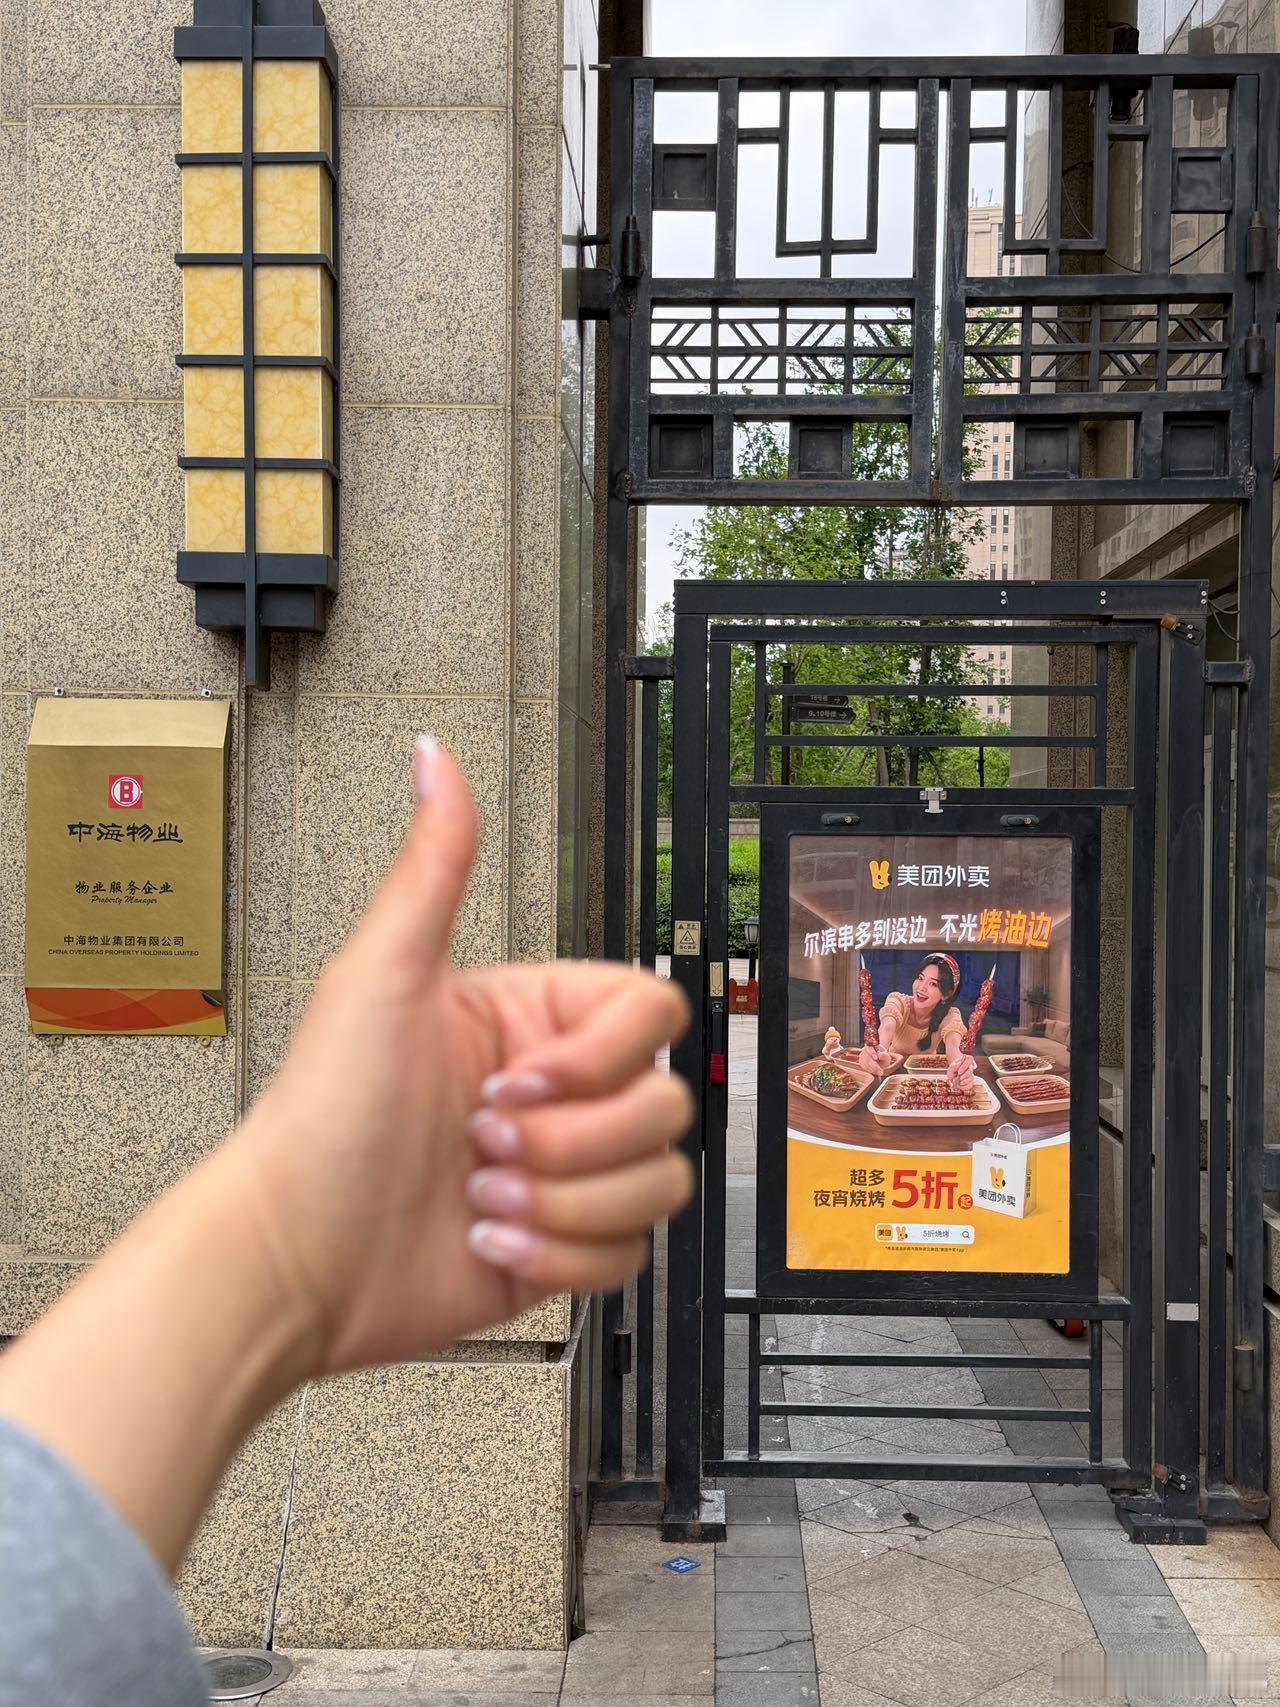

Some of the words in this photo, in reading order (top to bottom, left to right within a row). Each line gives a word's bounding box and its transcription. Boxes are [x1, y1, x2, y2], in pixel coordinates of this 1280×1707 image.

[67, 821, 184, 843] 中海物业
[897, 864, 990, 888] 美团外卖
[75, 880, 174, 895] 物业服务企业
[91, 894, 122, 905] Property
[124, 894, 158, 906] Manager
[63, 935, 185, 947] 中海物业集团有限公司
[804, 915, 928, 959] 尔滨串多到没边
[938, 908, 1054, 948] 不光烤油边
[850, 1169, 886, 1188] 超多
[813, 1190, 886, 1209] 夜宵烧烤
[978, 1188, 1016, 1207] 美团外卖
[922, 1229, 950, 1238] 5折烧烤
